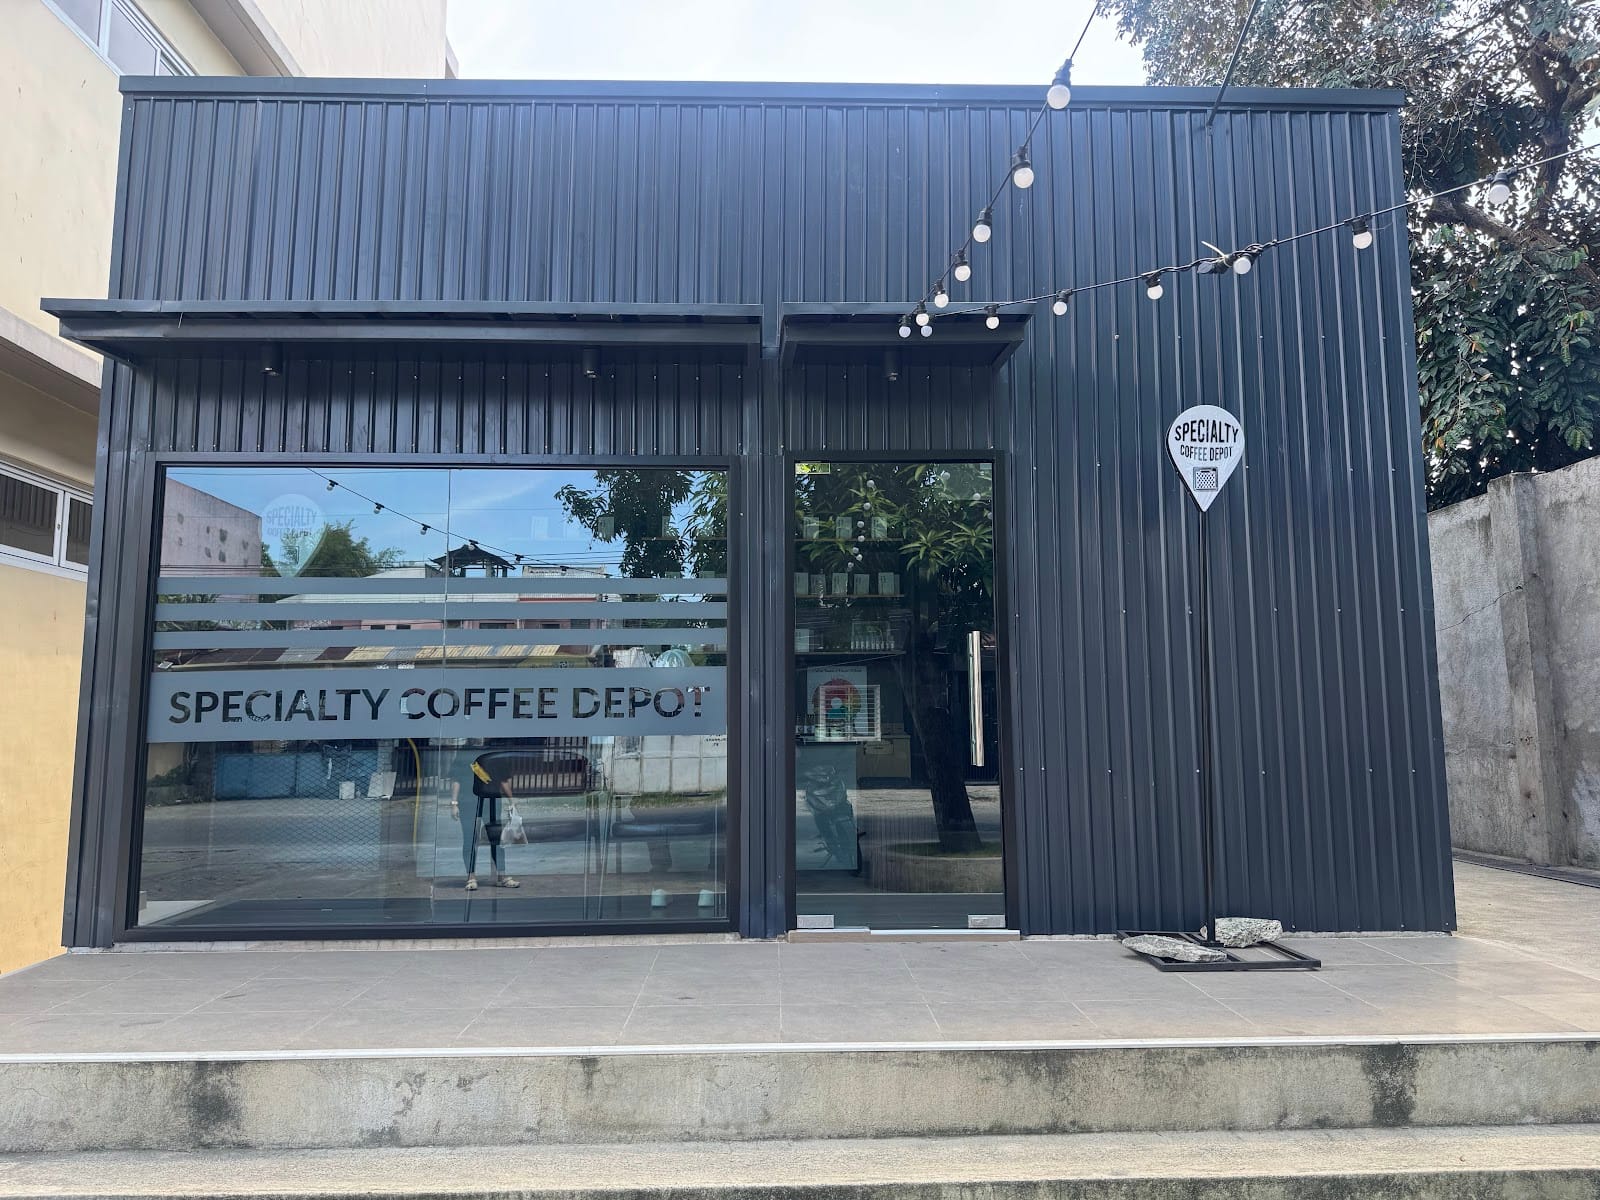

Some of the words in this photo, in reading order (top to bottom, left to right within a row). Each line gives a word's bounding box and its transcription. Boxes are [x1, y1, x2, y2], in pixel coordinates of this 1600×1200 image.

[1175, 419, 1239, 443] SPECIALTY
[1180, 444, 1207, 461] COFFEE
[1210, 446, 1233, 461] DEPOT
[266, 505, 317, 527] SPECIALTY
[168, 688, 391, 724] SPECIALTY
[399, 687, 559, 720] COFFEE
[572, 686, 712, 719] DEPOT
